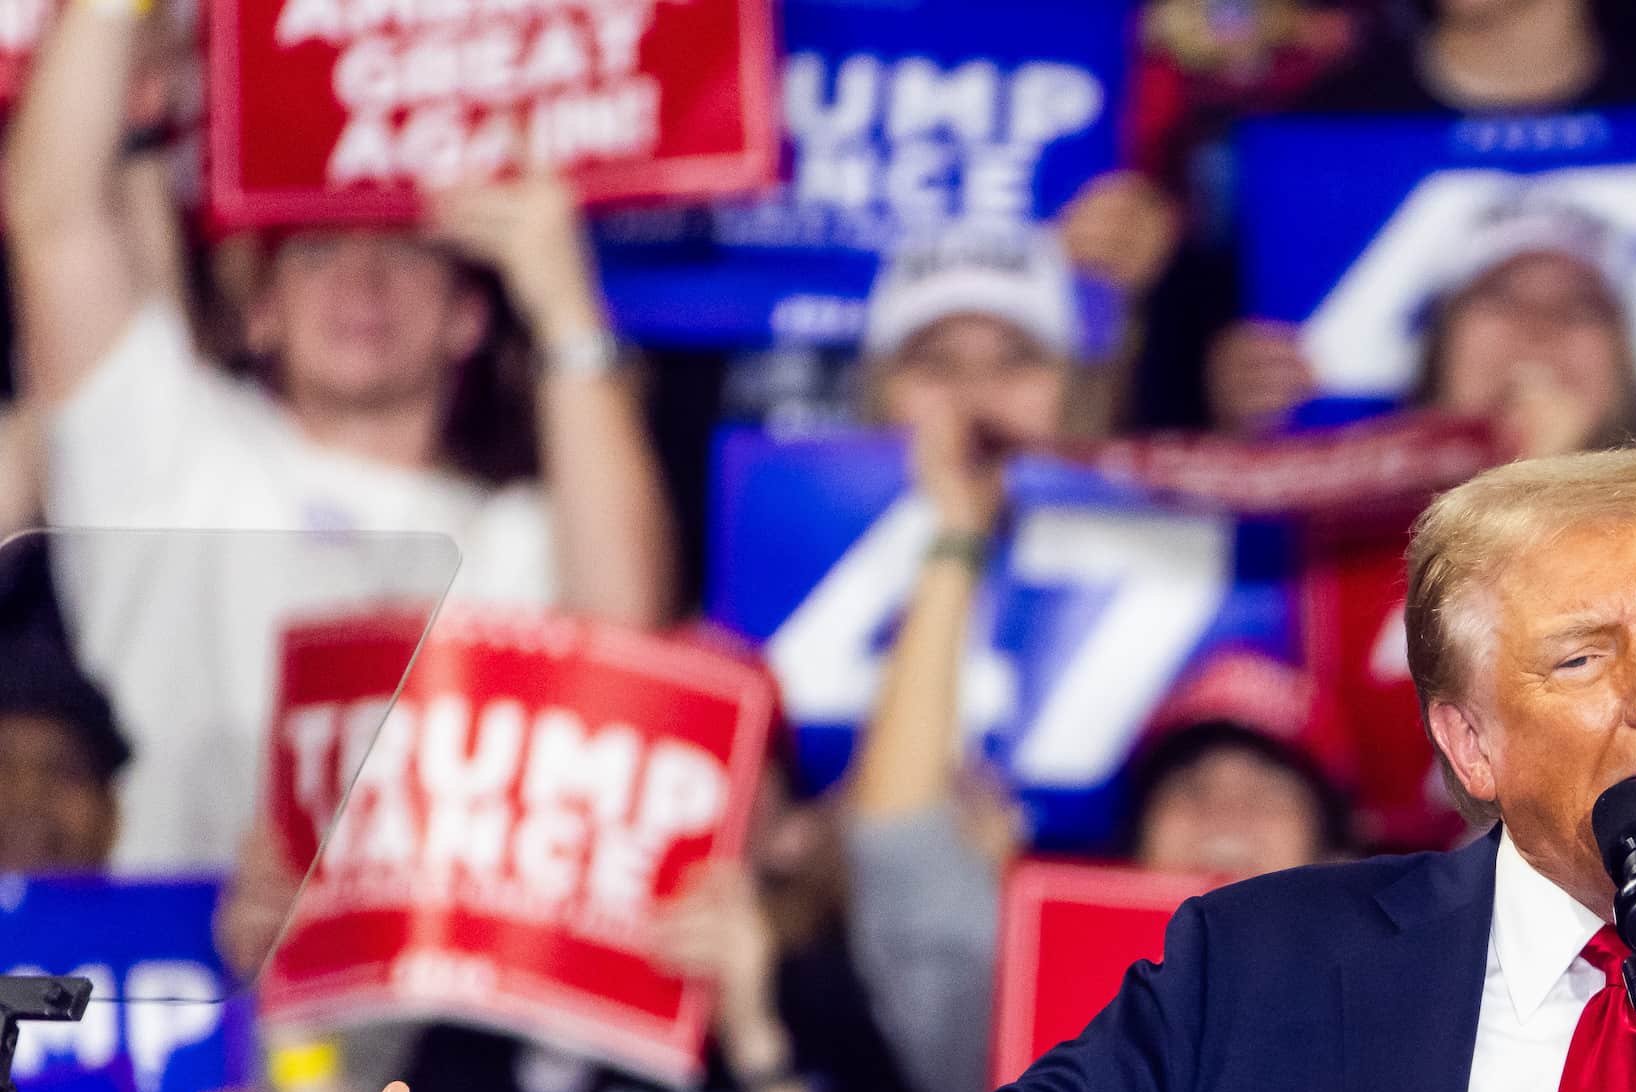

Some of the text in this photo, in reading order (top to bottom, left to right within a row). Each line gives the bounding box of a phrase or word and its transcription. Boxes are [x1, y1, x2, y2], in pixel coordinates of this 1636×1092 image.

[784, 52, 1104, 148] UMP
[796, 138, 1042, 226] NCE
[284, 690, 730, 842] TRUMP
